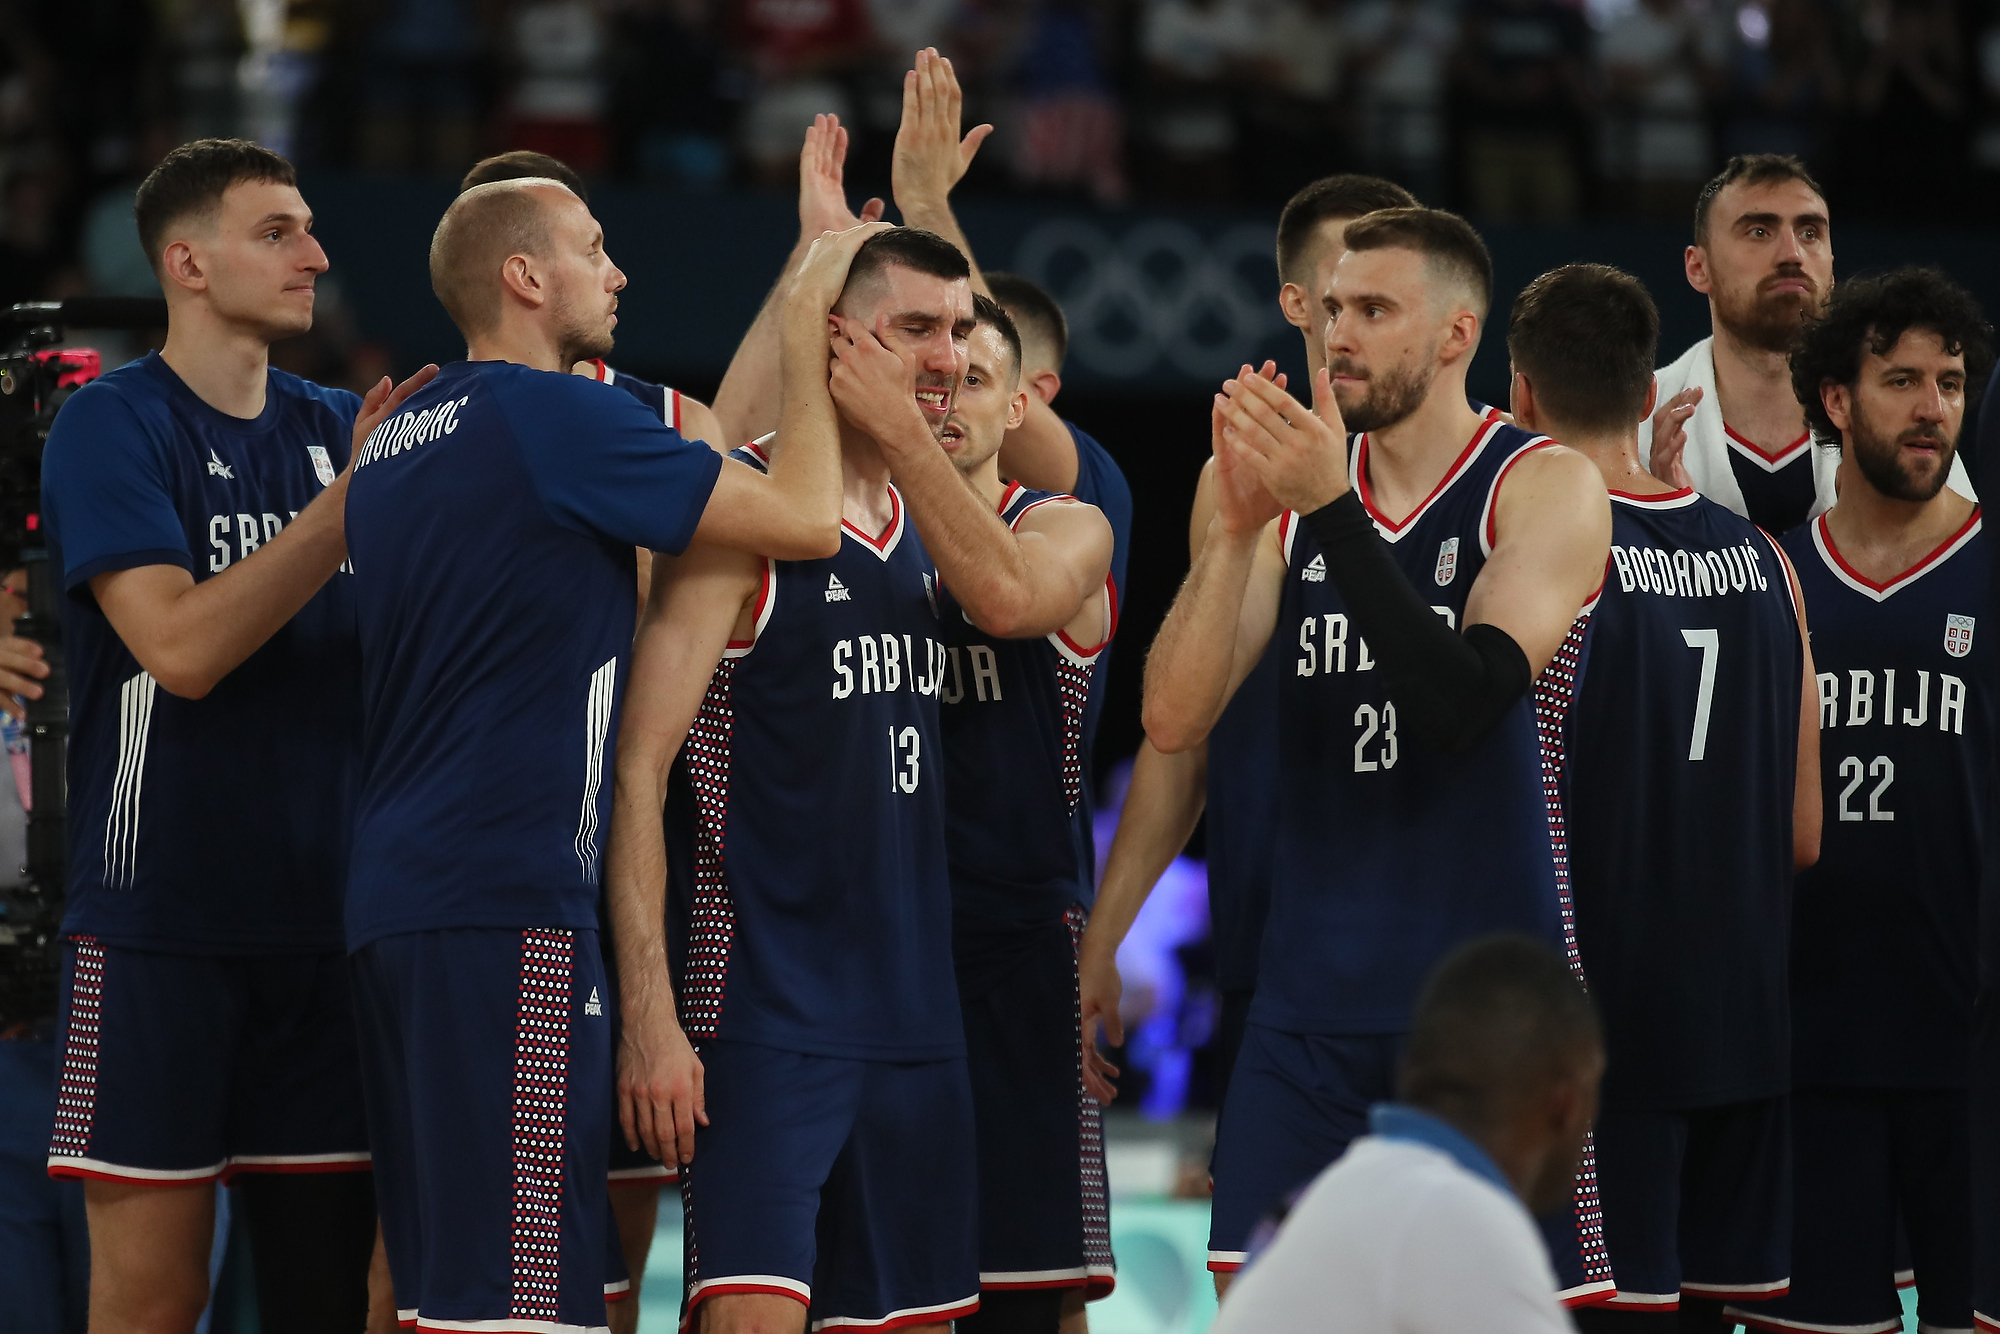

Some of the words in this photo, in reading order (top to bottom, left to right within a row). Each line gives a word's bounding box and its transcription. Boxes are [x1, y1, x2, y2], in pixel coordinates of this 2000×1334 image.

[824, 588, 852, 602] PEAK
[1301, 568, 1327, 583] PEA
[832, 633, 947, 700] SRBIJA
[1680, 628, 1719, 761] 7
[1816, 668, 1967, 736] RBIJA
[888, 725, 920, 794] 13
[1354, 700, 1398, 773] 23
[1839, 755, 1895, 821] 22
[584, 1002, 602, 1016] PEAK
